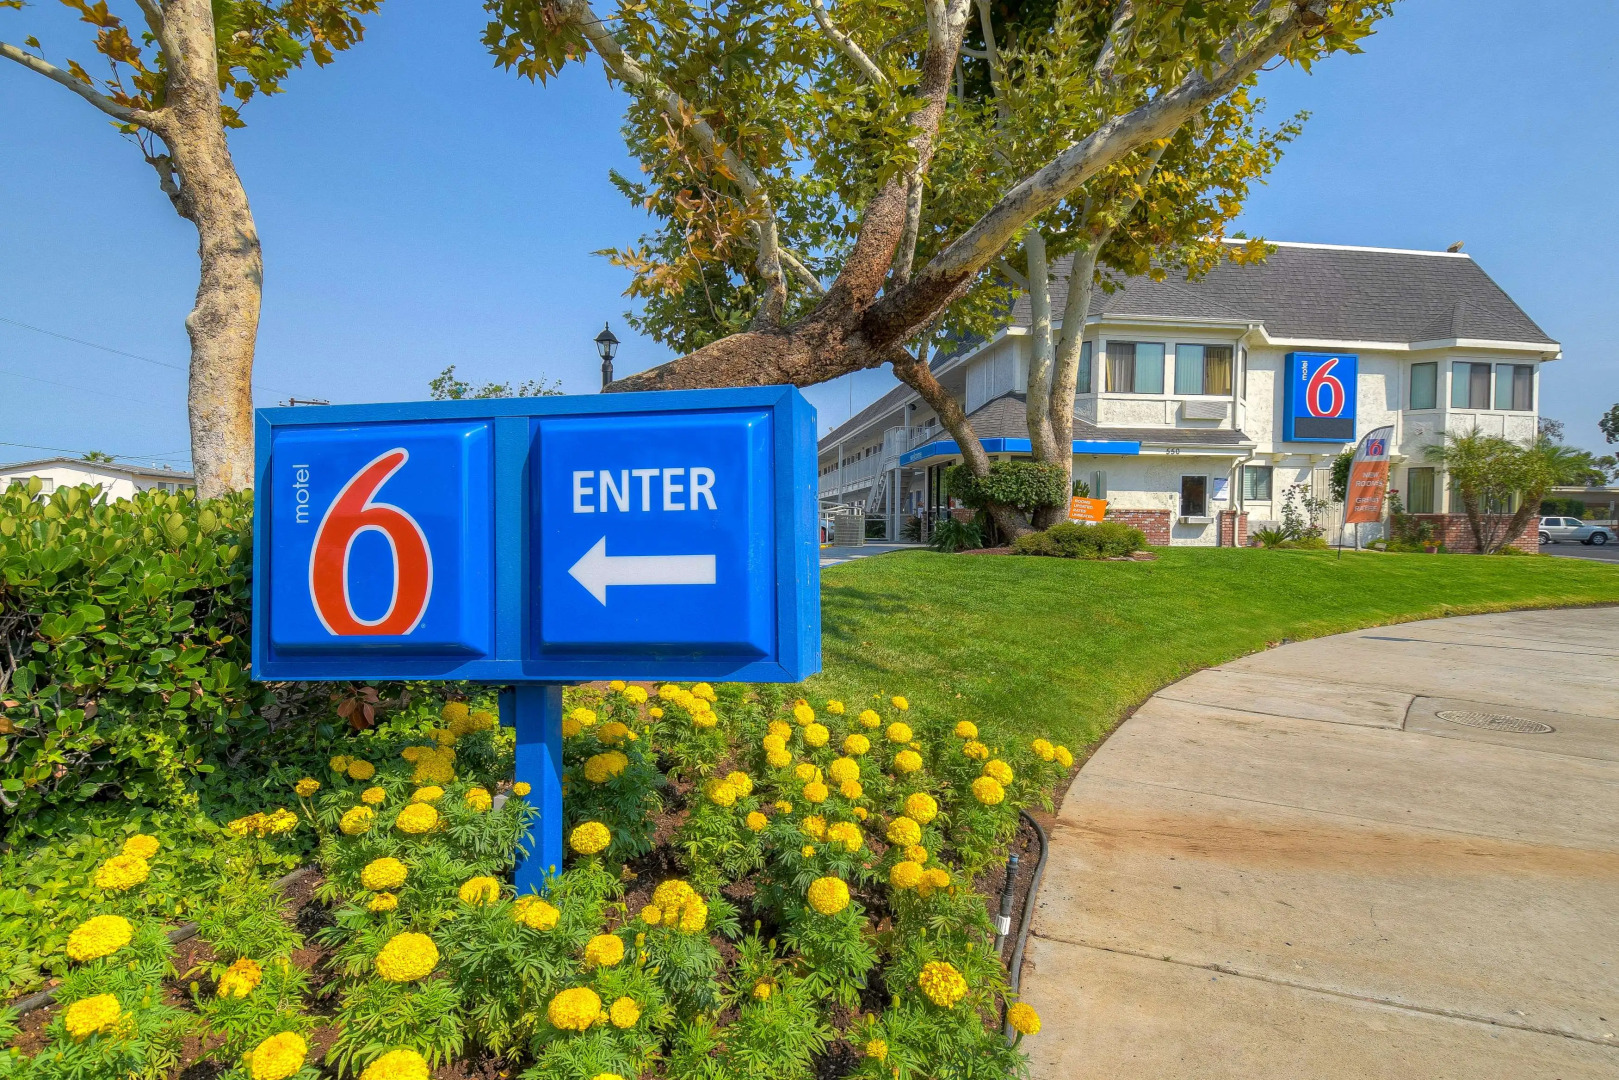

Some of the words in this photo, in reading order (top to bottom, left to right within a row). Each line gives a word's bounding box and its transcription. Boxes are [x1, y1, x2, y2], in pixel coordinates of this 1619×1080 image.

[1305, 357, 1346, 418] 6
[1368, 439, 1383, 457] 6
[292, 463, 310, 525] motel
[572, 467, 718, 514] ENTER
[308, 446, 434, 636] 6
